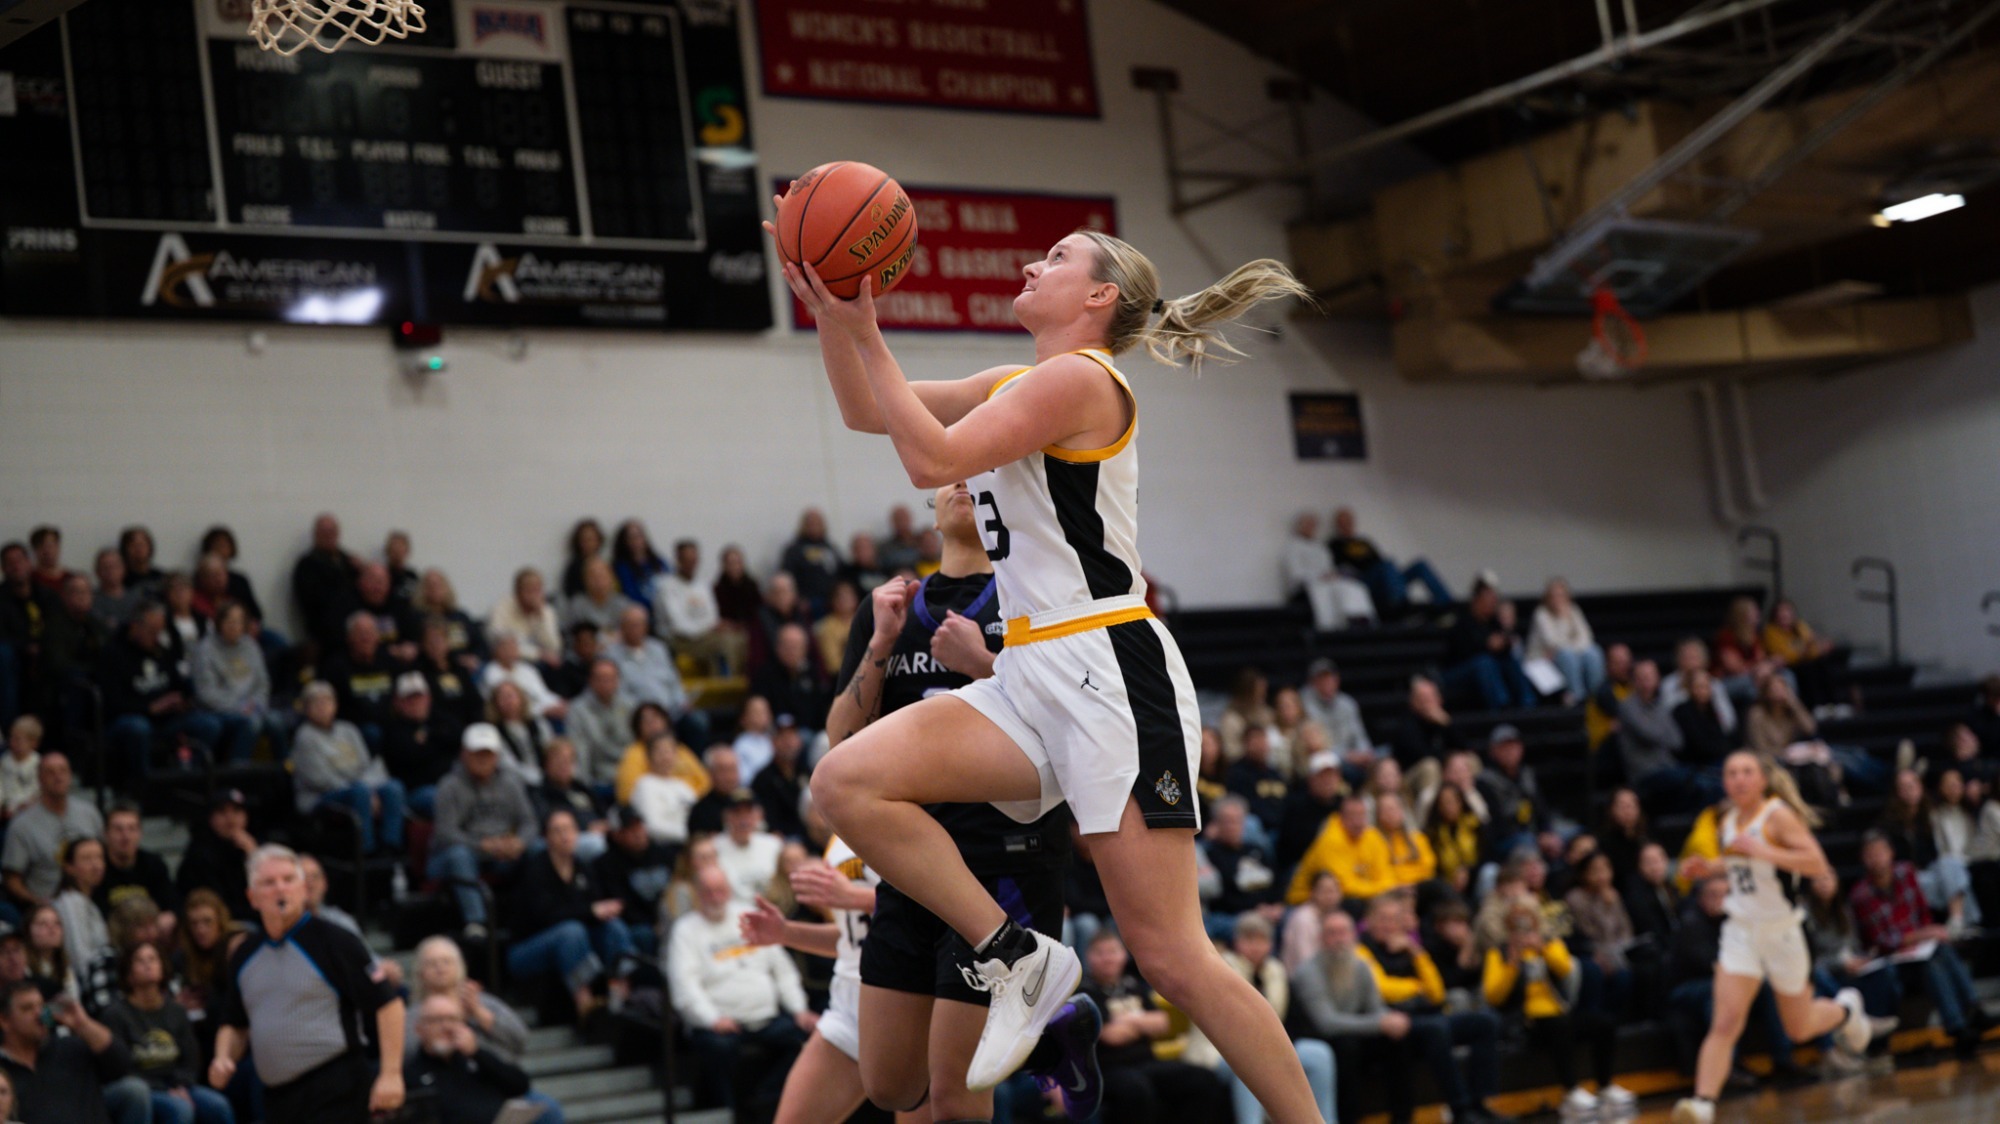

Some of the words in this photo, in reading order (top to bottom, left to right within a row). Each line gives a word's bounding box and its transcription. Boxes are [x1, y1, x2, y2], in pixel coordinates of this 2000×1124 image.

[905, 19, 1063, 63] BASKETBALL
[475, 61, 543, 90] GUEST
[807, 57, 930, 97] NATIONAL
[936, 67, 1059, 106] CHAMPION
[849, 190, 910, 265] SPALDING
[209, 250, 378, 285] AMERICAN
[515, 252, 666, 288] AMERICAN
[970, 490, 1010, 562] 3
[885, 651, 948, 680] WARR
